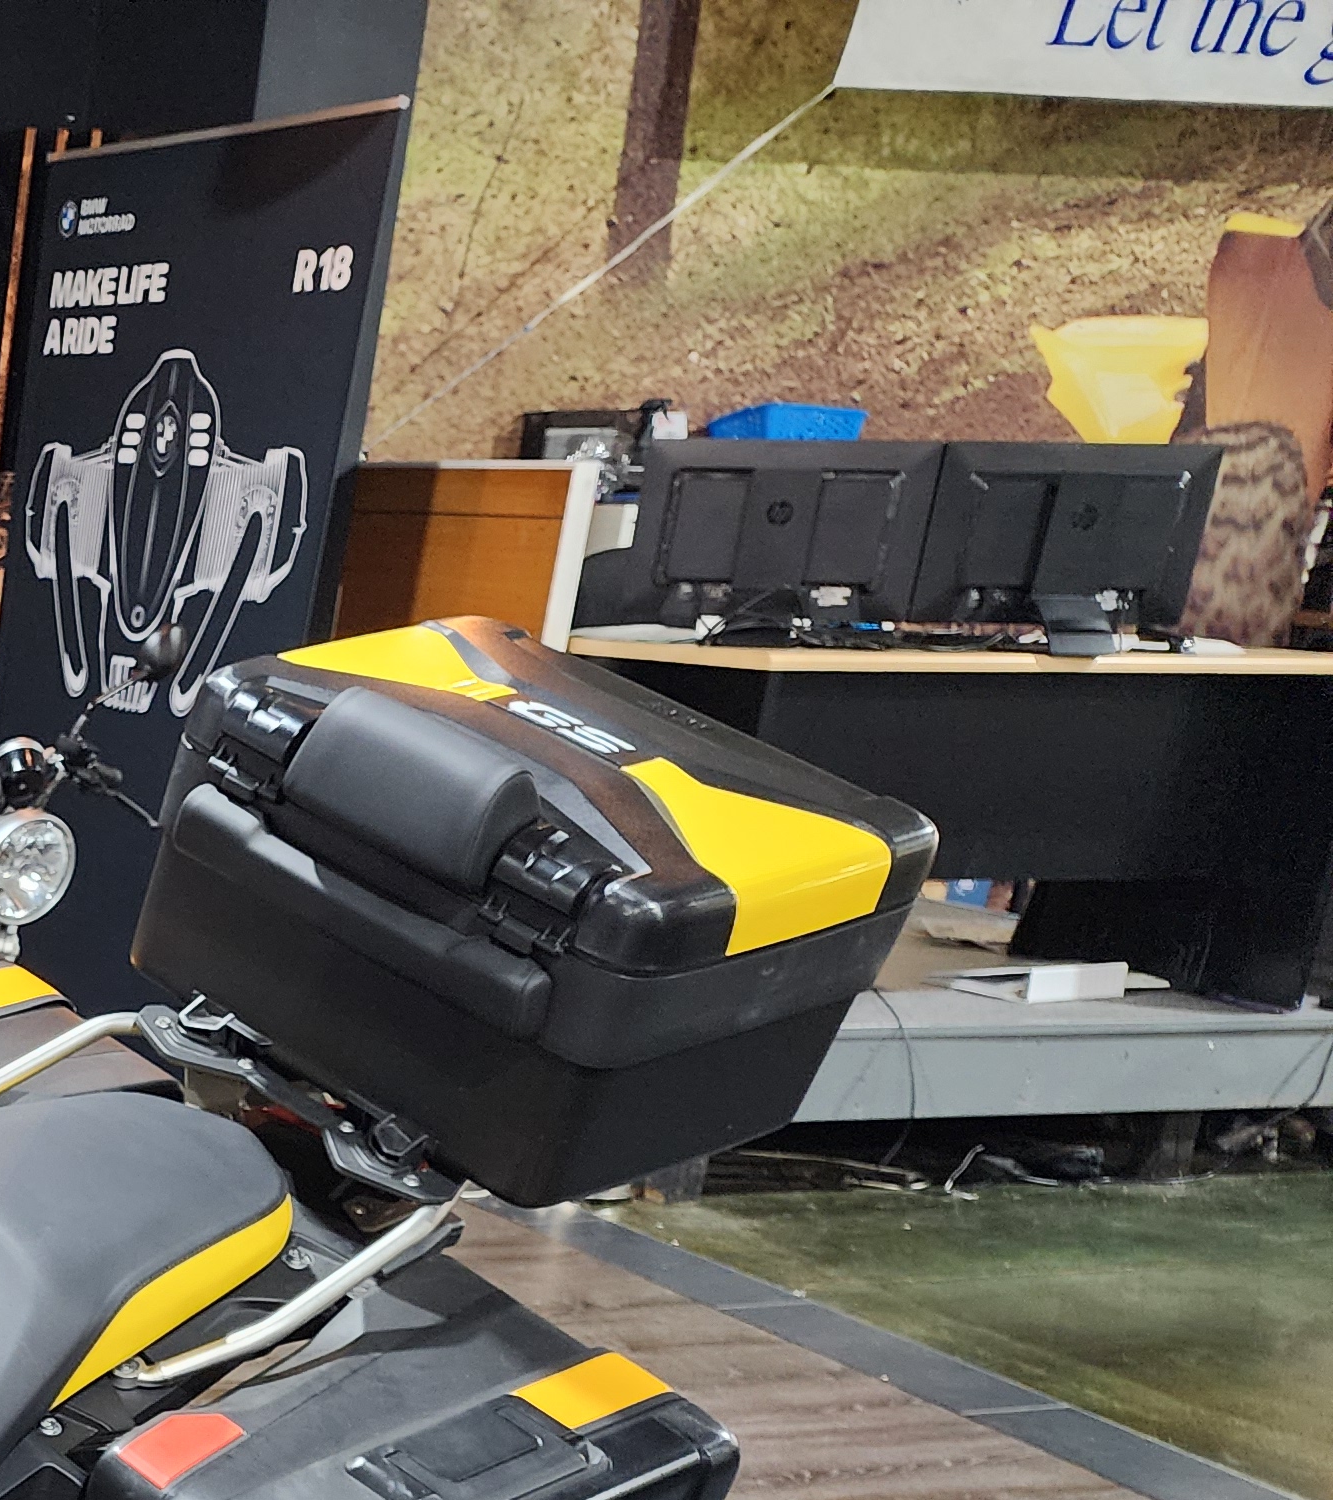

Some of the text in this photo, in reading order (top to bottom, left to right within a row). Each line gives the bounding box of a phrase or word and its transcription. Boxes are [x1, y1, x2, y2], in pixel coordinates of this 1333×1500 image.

[49, 262, 170, 309] MAKE LIFE
[61, 315, 118, 355] RIDE
